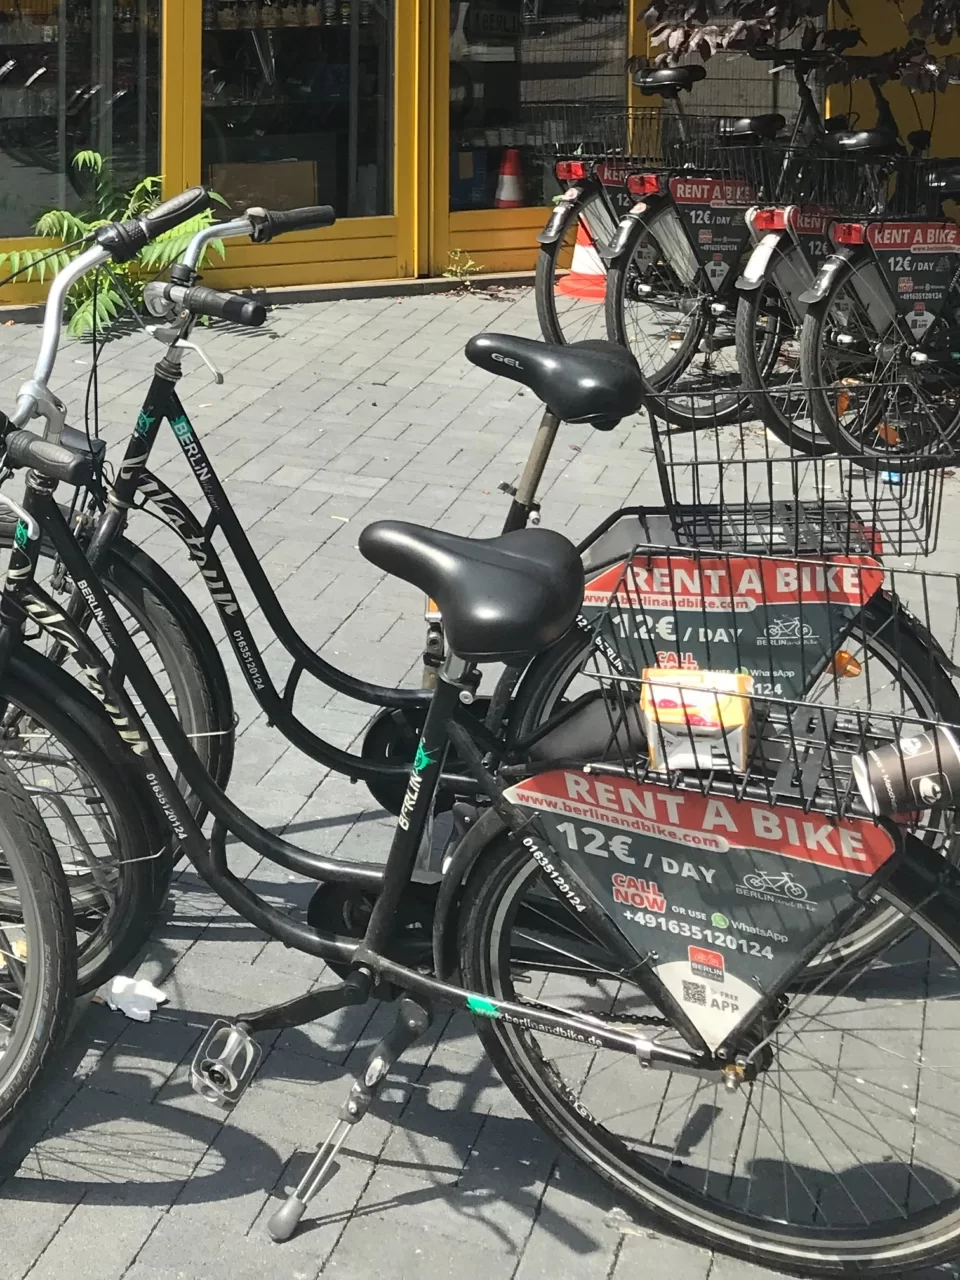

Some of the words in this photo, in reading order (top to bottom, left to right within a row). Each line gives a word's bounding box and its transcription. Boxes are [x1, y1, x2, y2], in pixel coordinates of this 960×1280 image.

[603, 167, 628, 181] REN
[676, 183, 710, 198] RENT
[712, 185, 722, 198] A
[725, 186, 750, 199] BIKE
[689, 210, 711, 224] 12€
[716, 217, 731, 225] DAY
[809, 241, 828, 255] 12€
[874, 229, 910, 244] RENT
[913, 229, 923, 243] A
[927, 229, 957, 243] BIKE
[888, 256, 912, 272] 12€
[918, 262, 934, 271] DAY
[491, 352, 525, 370] GEL
[174, 422, 212, 481] BERLIN
[626, 566, 726, 595] RENT
[737, 568, 763, 595] A
[776, 567, 860, 594] BIKE
[77, 578, 106, 625] BERLIN
[612, 613, 677, 641] 12€
[698, 628, 743, 643] DAY
[233, 630, 265, 691] 01635120124
[146, 773, 188, 840] 01635120124
[565, 772, 684, 824] RENT
[702, 799, 738, 832] A
[751, 807, 867, 861] BIKE
[517, 792, 719, 849] www.berlinandbike.com
[556, 822, 636, 865] 12€
[661, 856, 715, 884] DAY
[522, 837, 587, 912] 01635120124
[612, 873, 663, 897] CALL
[736, 887, 775, 902] BERLIN
[613, 887, 666, 914] NOW
[671, 905, 686, 916] OR
[688, 909, 707, 921] USE
[731, 920, 788, 943] WhatsApp
[623, 910, 774, 960] +491635120124
[691, 962, 723, 977] BERLIN
[710, 998, 740, 1014] APP
[720, 991, 739, 1002] FREE
